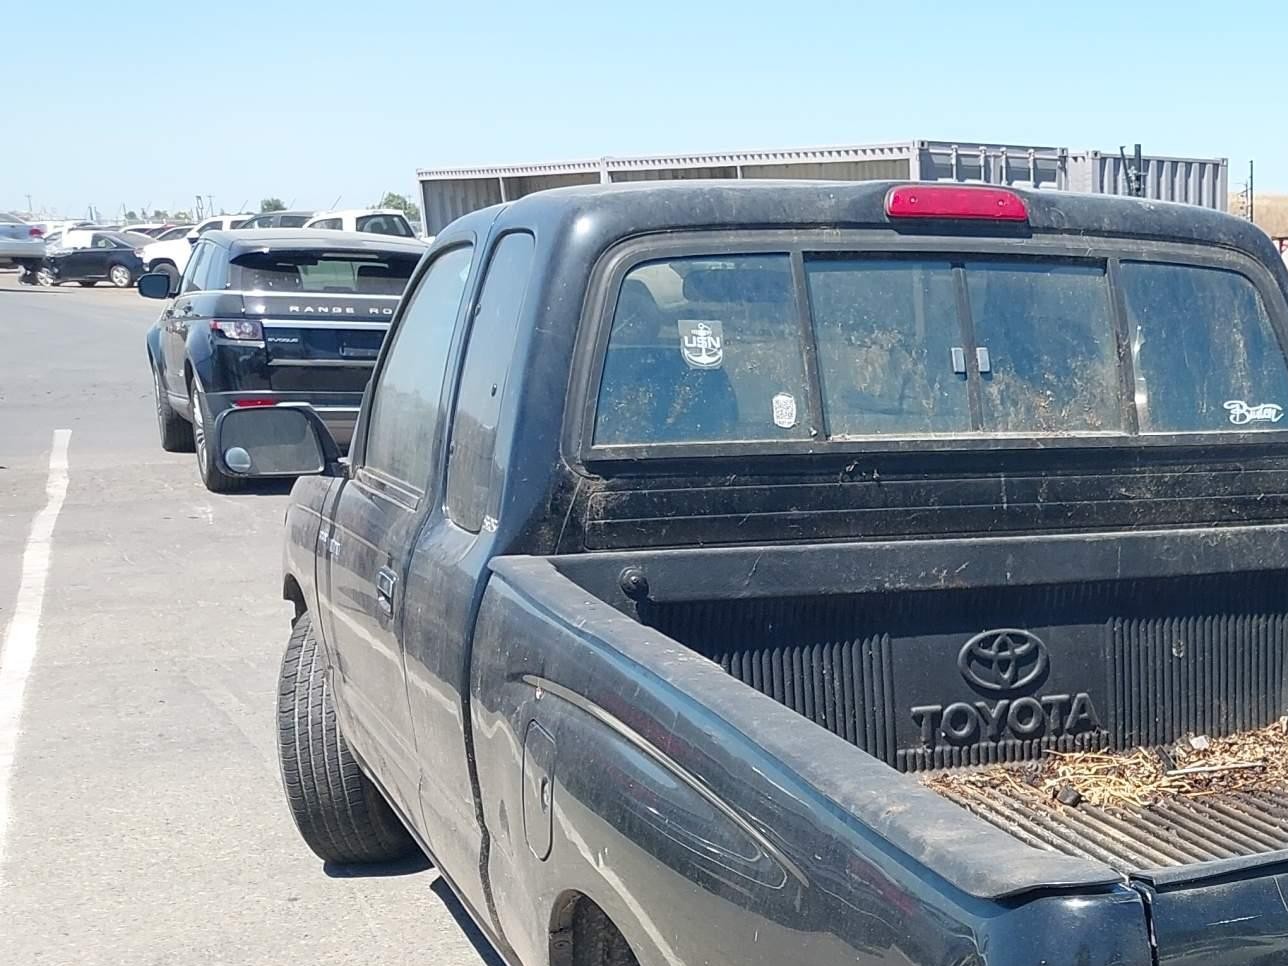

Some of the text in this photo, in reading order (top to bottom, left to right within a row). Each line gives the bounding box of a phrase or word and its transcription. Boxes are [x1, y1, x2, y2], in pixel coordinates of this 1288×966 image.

[289, 305, 355, 314] RANGE
[684, 335, 721, 348] USN
[911, 693, 1102, 743] TOYOTA
